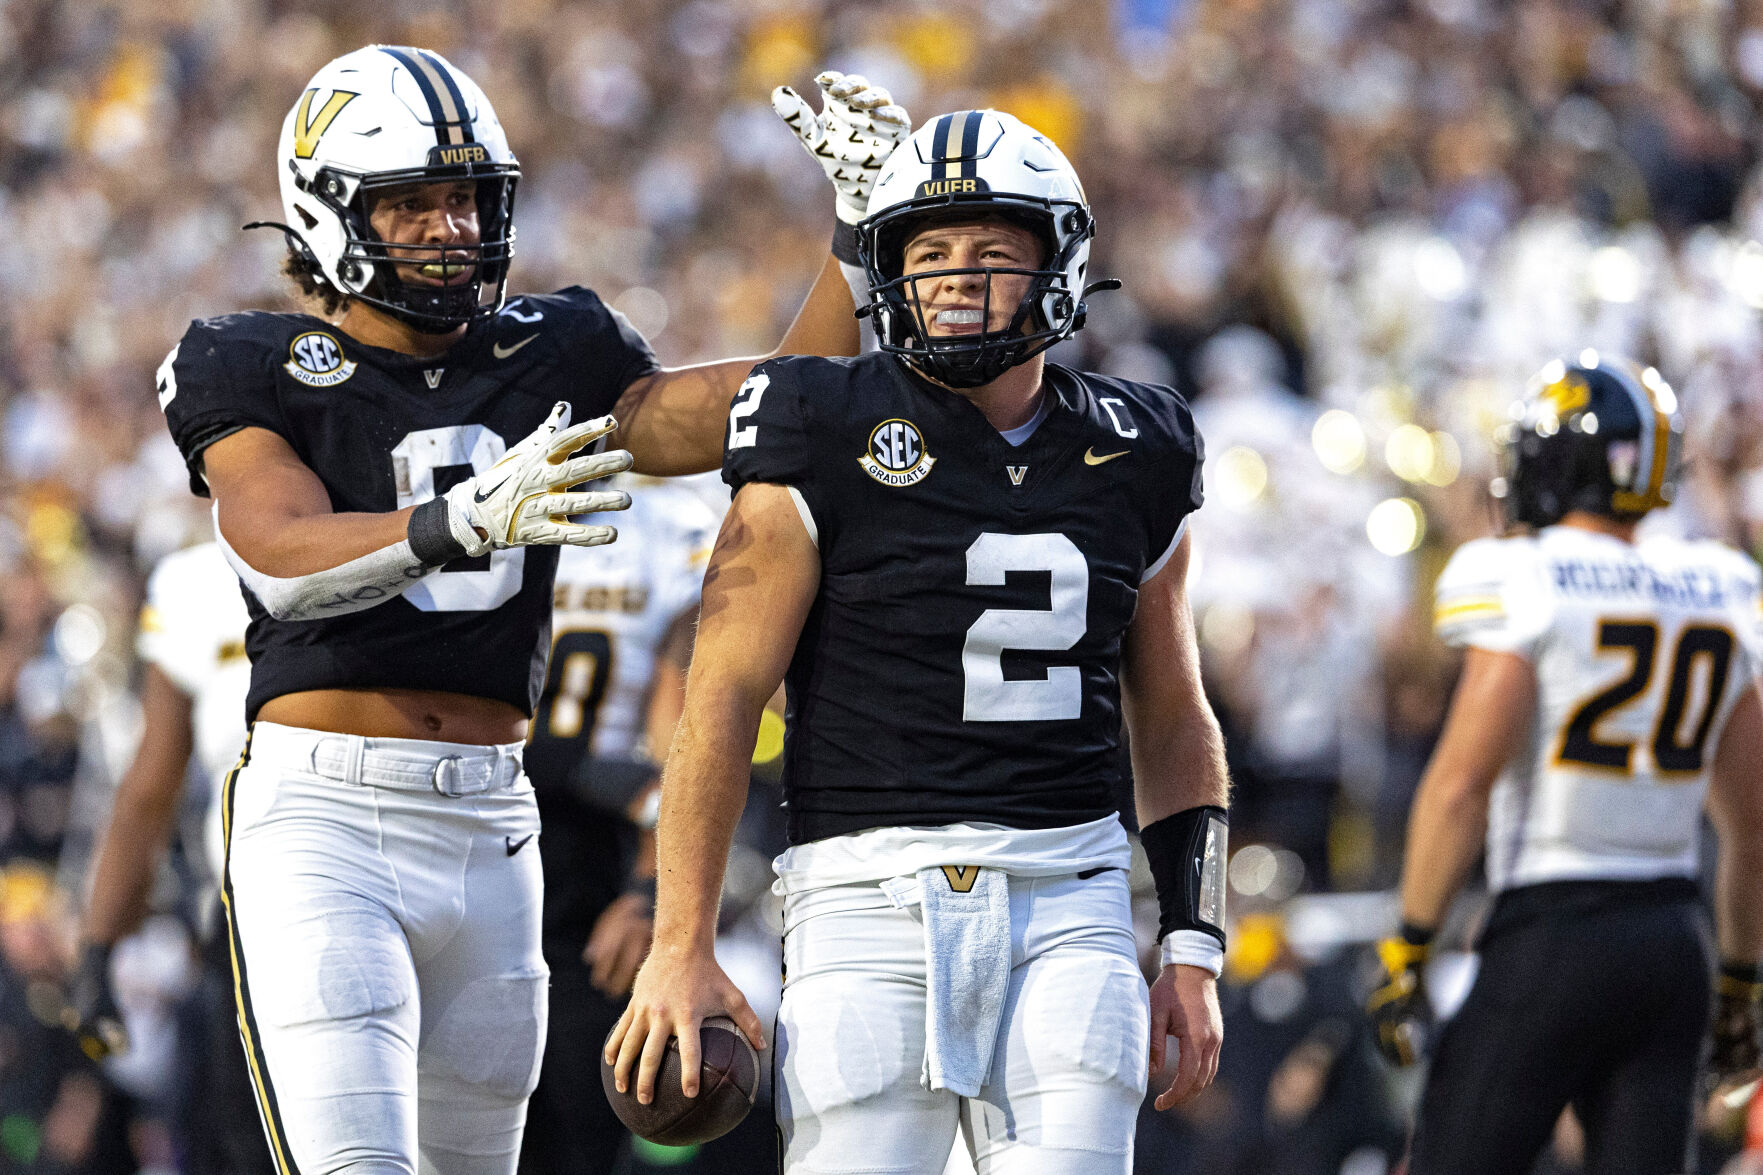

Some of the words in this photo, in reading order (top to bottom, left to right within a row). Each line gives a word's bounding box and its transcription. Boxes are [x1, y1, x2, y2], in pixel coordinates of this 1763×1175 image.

[295, 88, 362, 159] V
[440, 146, 485, 165] VUFB
[924, 179, 976, 196] VUFB
[294, 335, 340, 372] SEC
[295, 369, 351, 385] GRADUATE
[423, 368, 444, 389] V
[729, 374, 769, 450] 2
[1100, 398, 1138, 439] C
[874, 423, 919, 468] SEC
[869, 465, 927, 485] GRADUATE
[1006, 465, 1028, 485] V
[962, 532, 1089, 722] 2
[1552, 617, 1735, 777] 20
[940, 866, 981, 893] V
